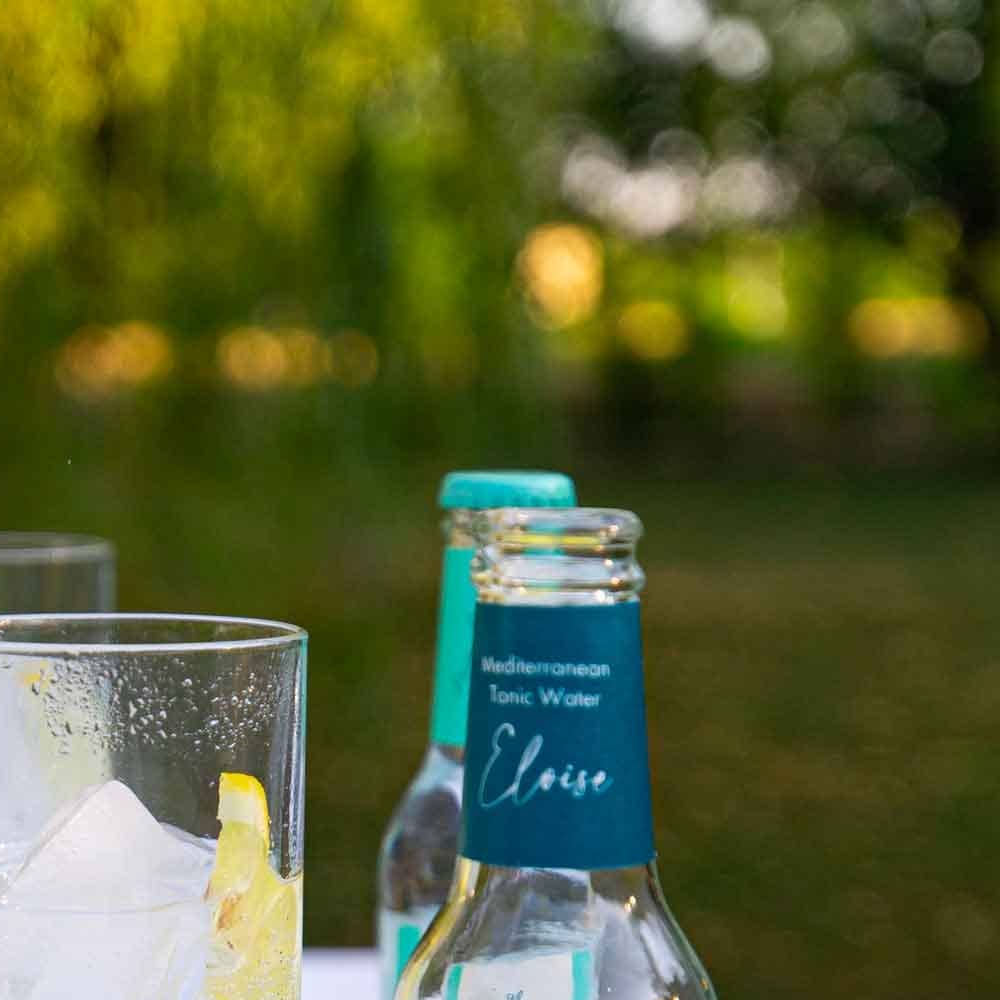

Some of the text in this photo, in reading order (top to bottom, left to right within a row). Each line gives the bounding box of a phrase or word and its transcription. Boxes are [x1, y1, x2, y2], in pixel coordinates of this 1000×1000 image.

[480, 655, 611, 678] Mediterranean
[489, 683, 601, 708] Tonic Water
[478, 722, 614, 808] Eloise
